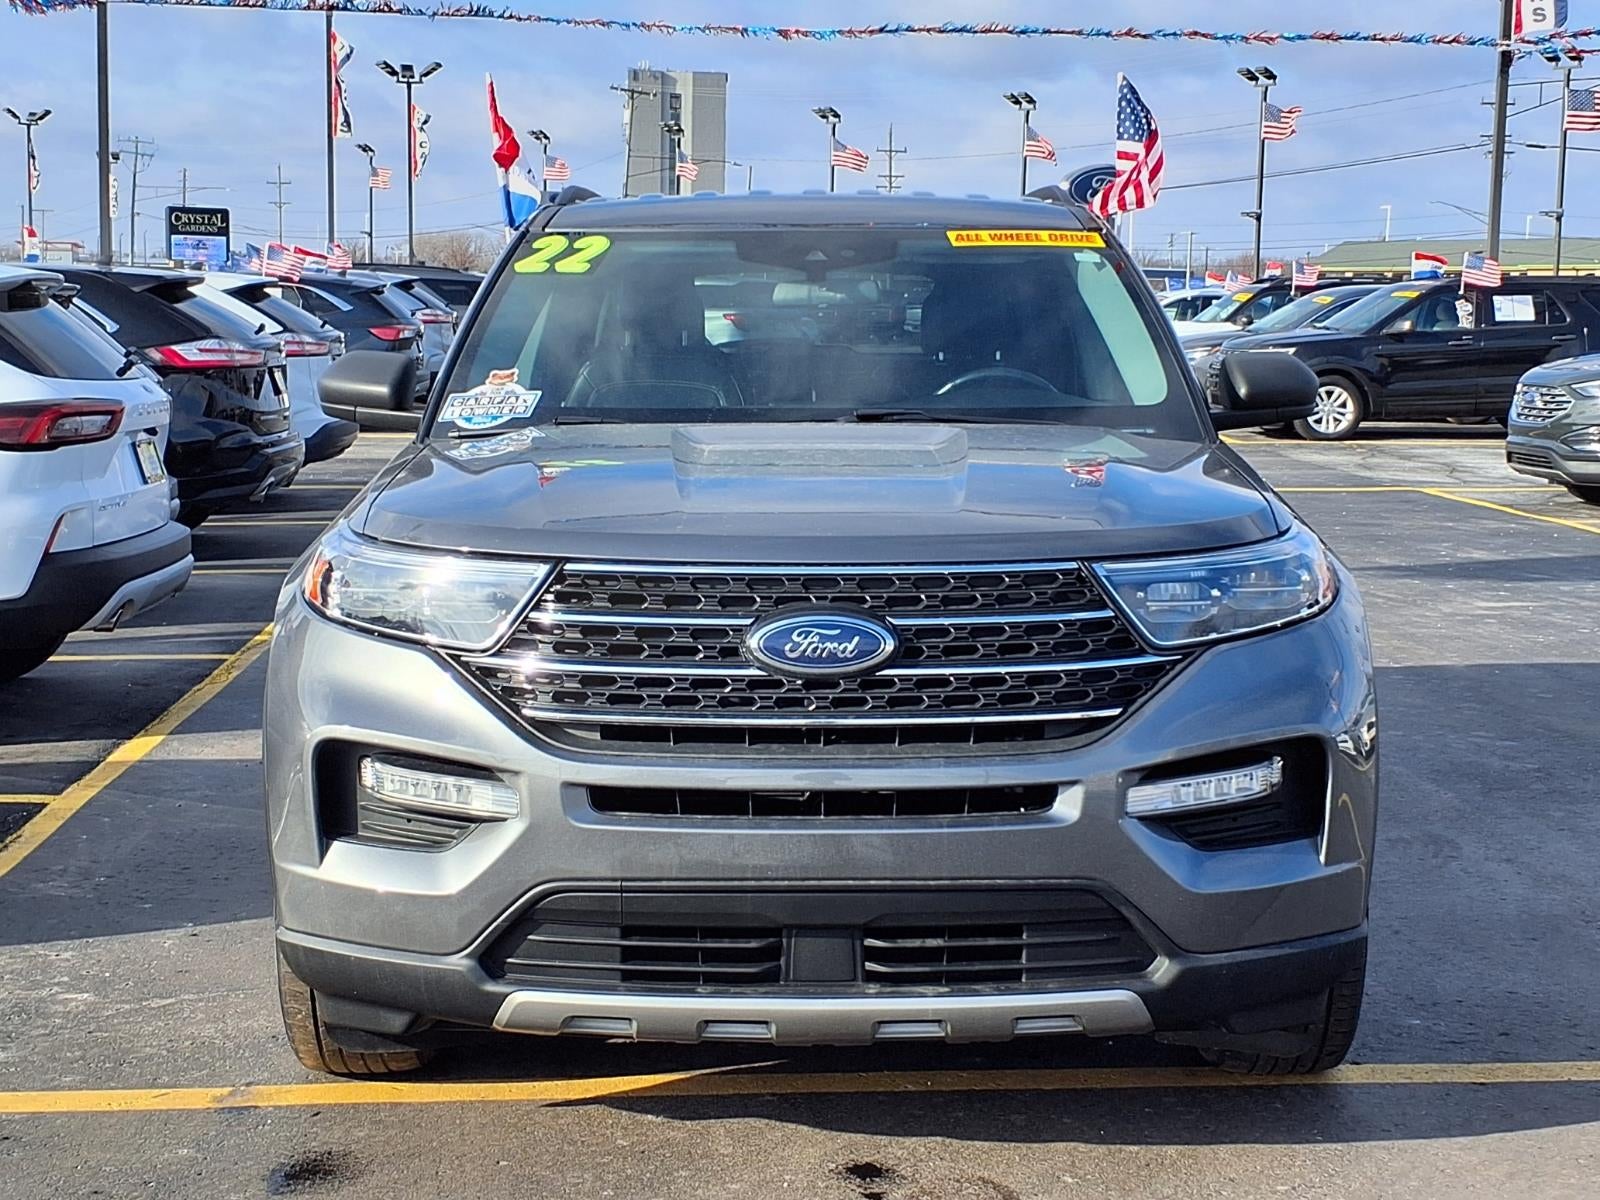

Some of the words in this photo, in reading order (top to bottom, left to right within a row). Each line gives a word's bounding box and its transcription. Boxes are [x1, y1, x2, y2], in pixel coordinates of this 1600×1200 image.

[171, 212, 226, 227] CRYSTAL
[178, 224, 218, 232] GARDENS
[954, 233, 983, 242] ALL
[988, 233, 1044, 242] WHEEL
[1048, 233, 1097, 243] DRIVE
[514, 235, 610, 273] 22
[451, 395, 529, 407] CARFAX
[784, 627, 860, 658] Ford
